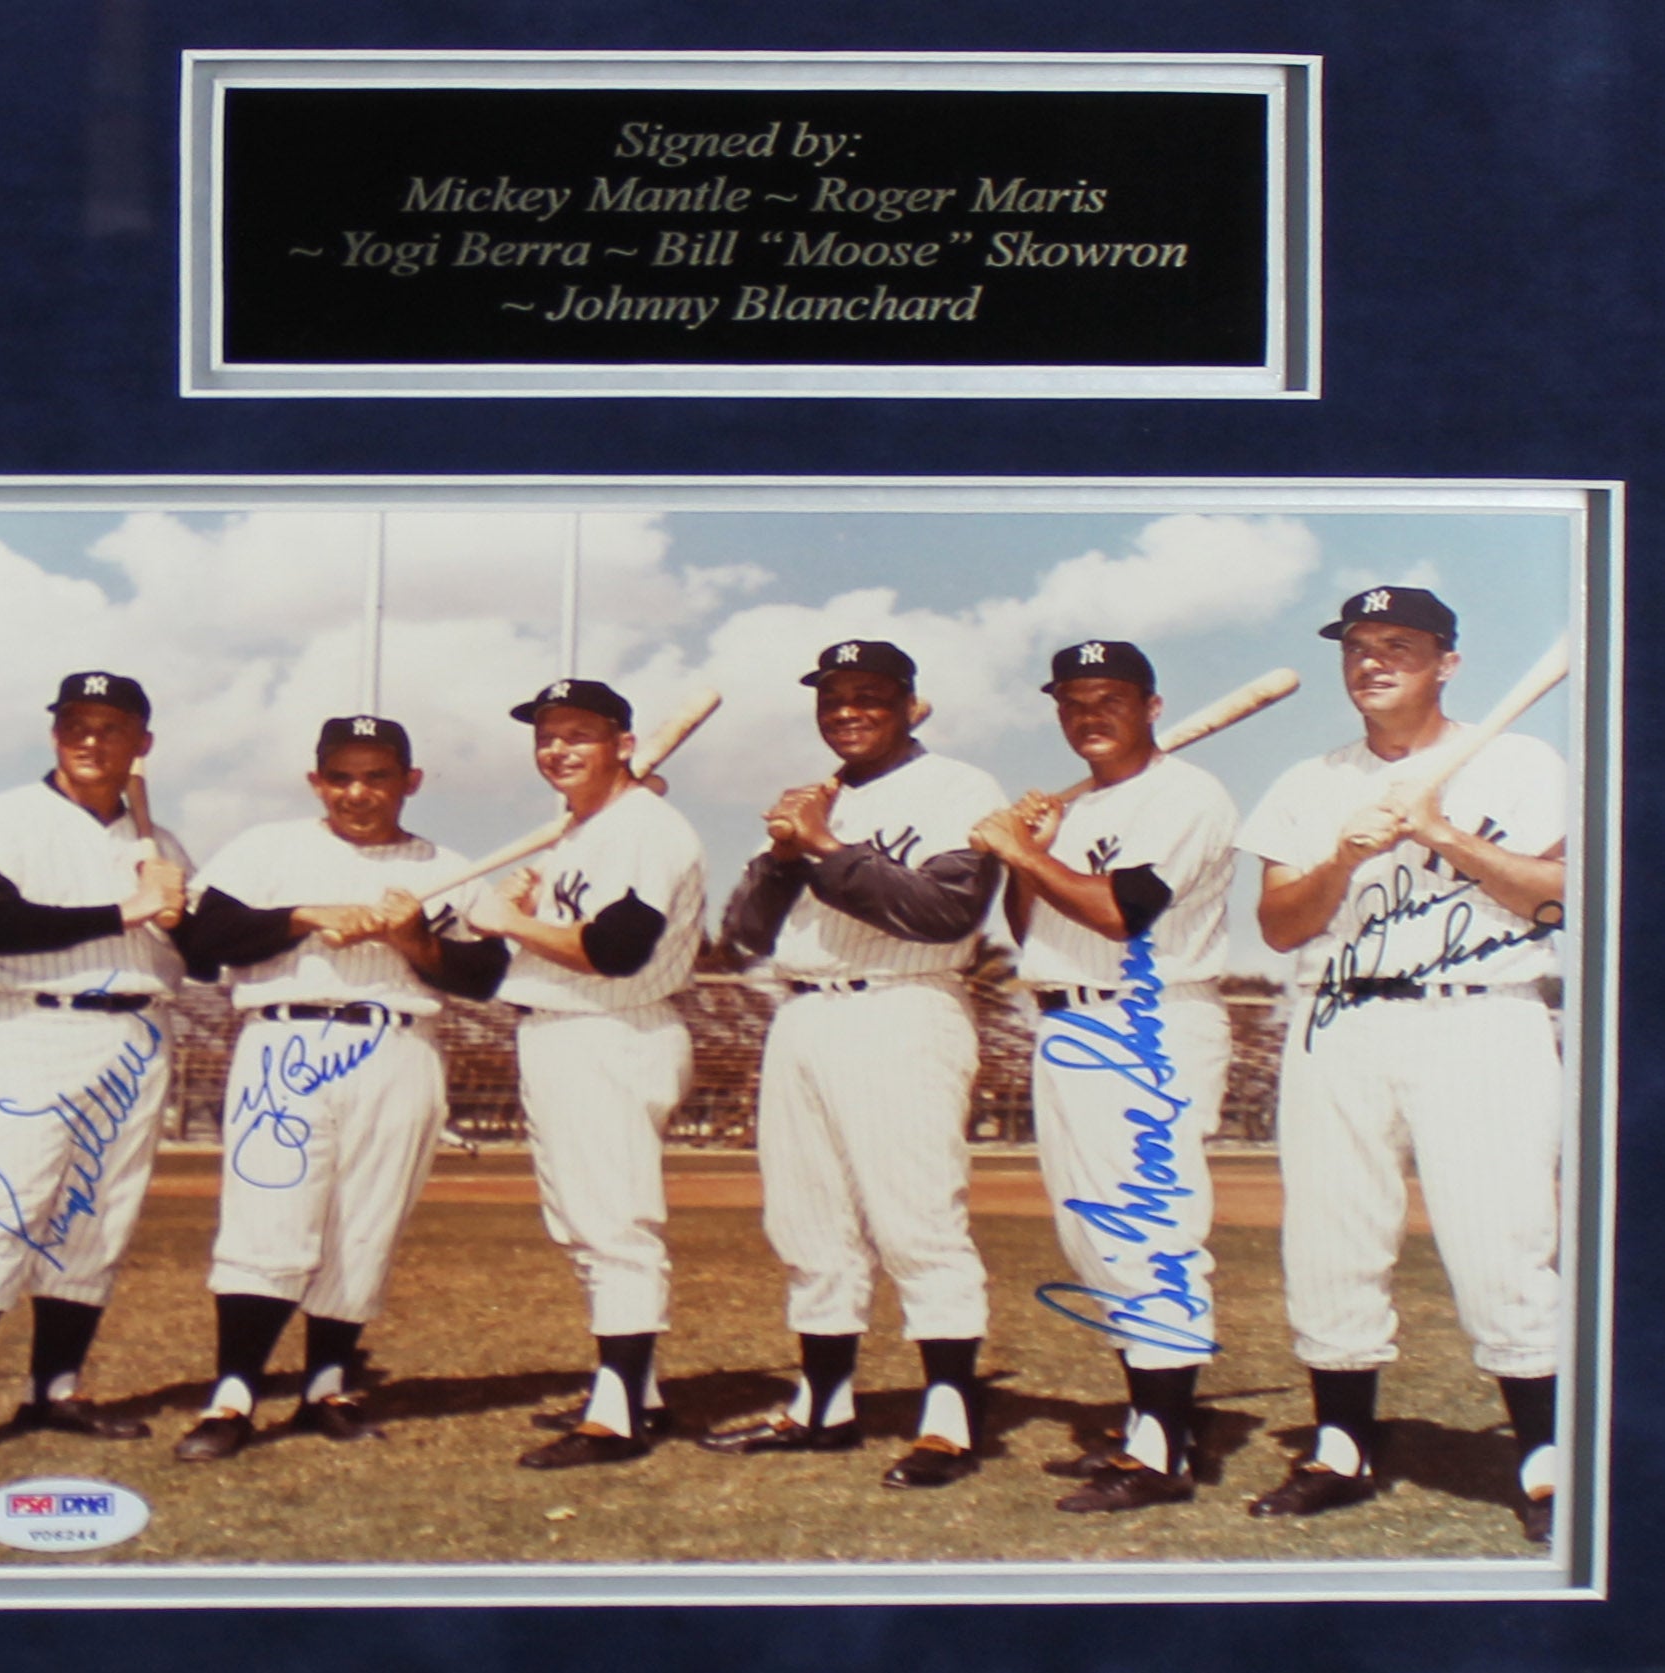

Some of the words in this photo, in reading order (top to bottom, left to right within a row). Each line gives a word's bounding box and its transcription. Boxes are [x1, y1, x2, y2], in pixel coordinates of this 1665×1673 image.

[615, 121, 781, 167] Signed
[791, 121, 862, 167] by:
[402, 176, 571, 221] Mickey
[587, 175, 752, 213] Mantle
[812, 177, 957, 221] Roger
[970, 177, 1108, 213] Maris
[343, 231, 441, 275] Yogi
[454, 231, 591, 267] Berra
[653, 230, 739, 266] Bill
[984, 230, 1189, 268] Skowron
[545, 284, 720, 330] Johnny
[732, 284, 984, 322] Blanchard
